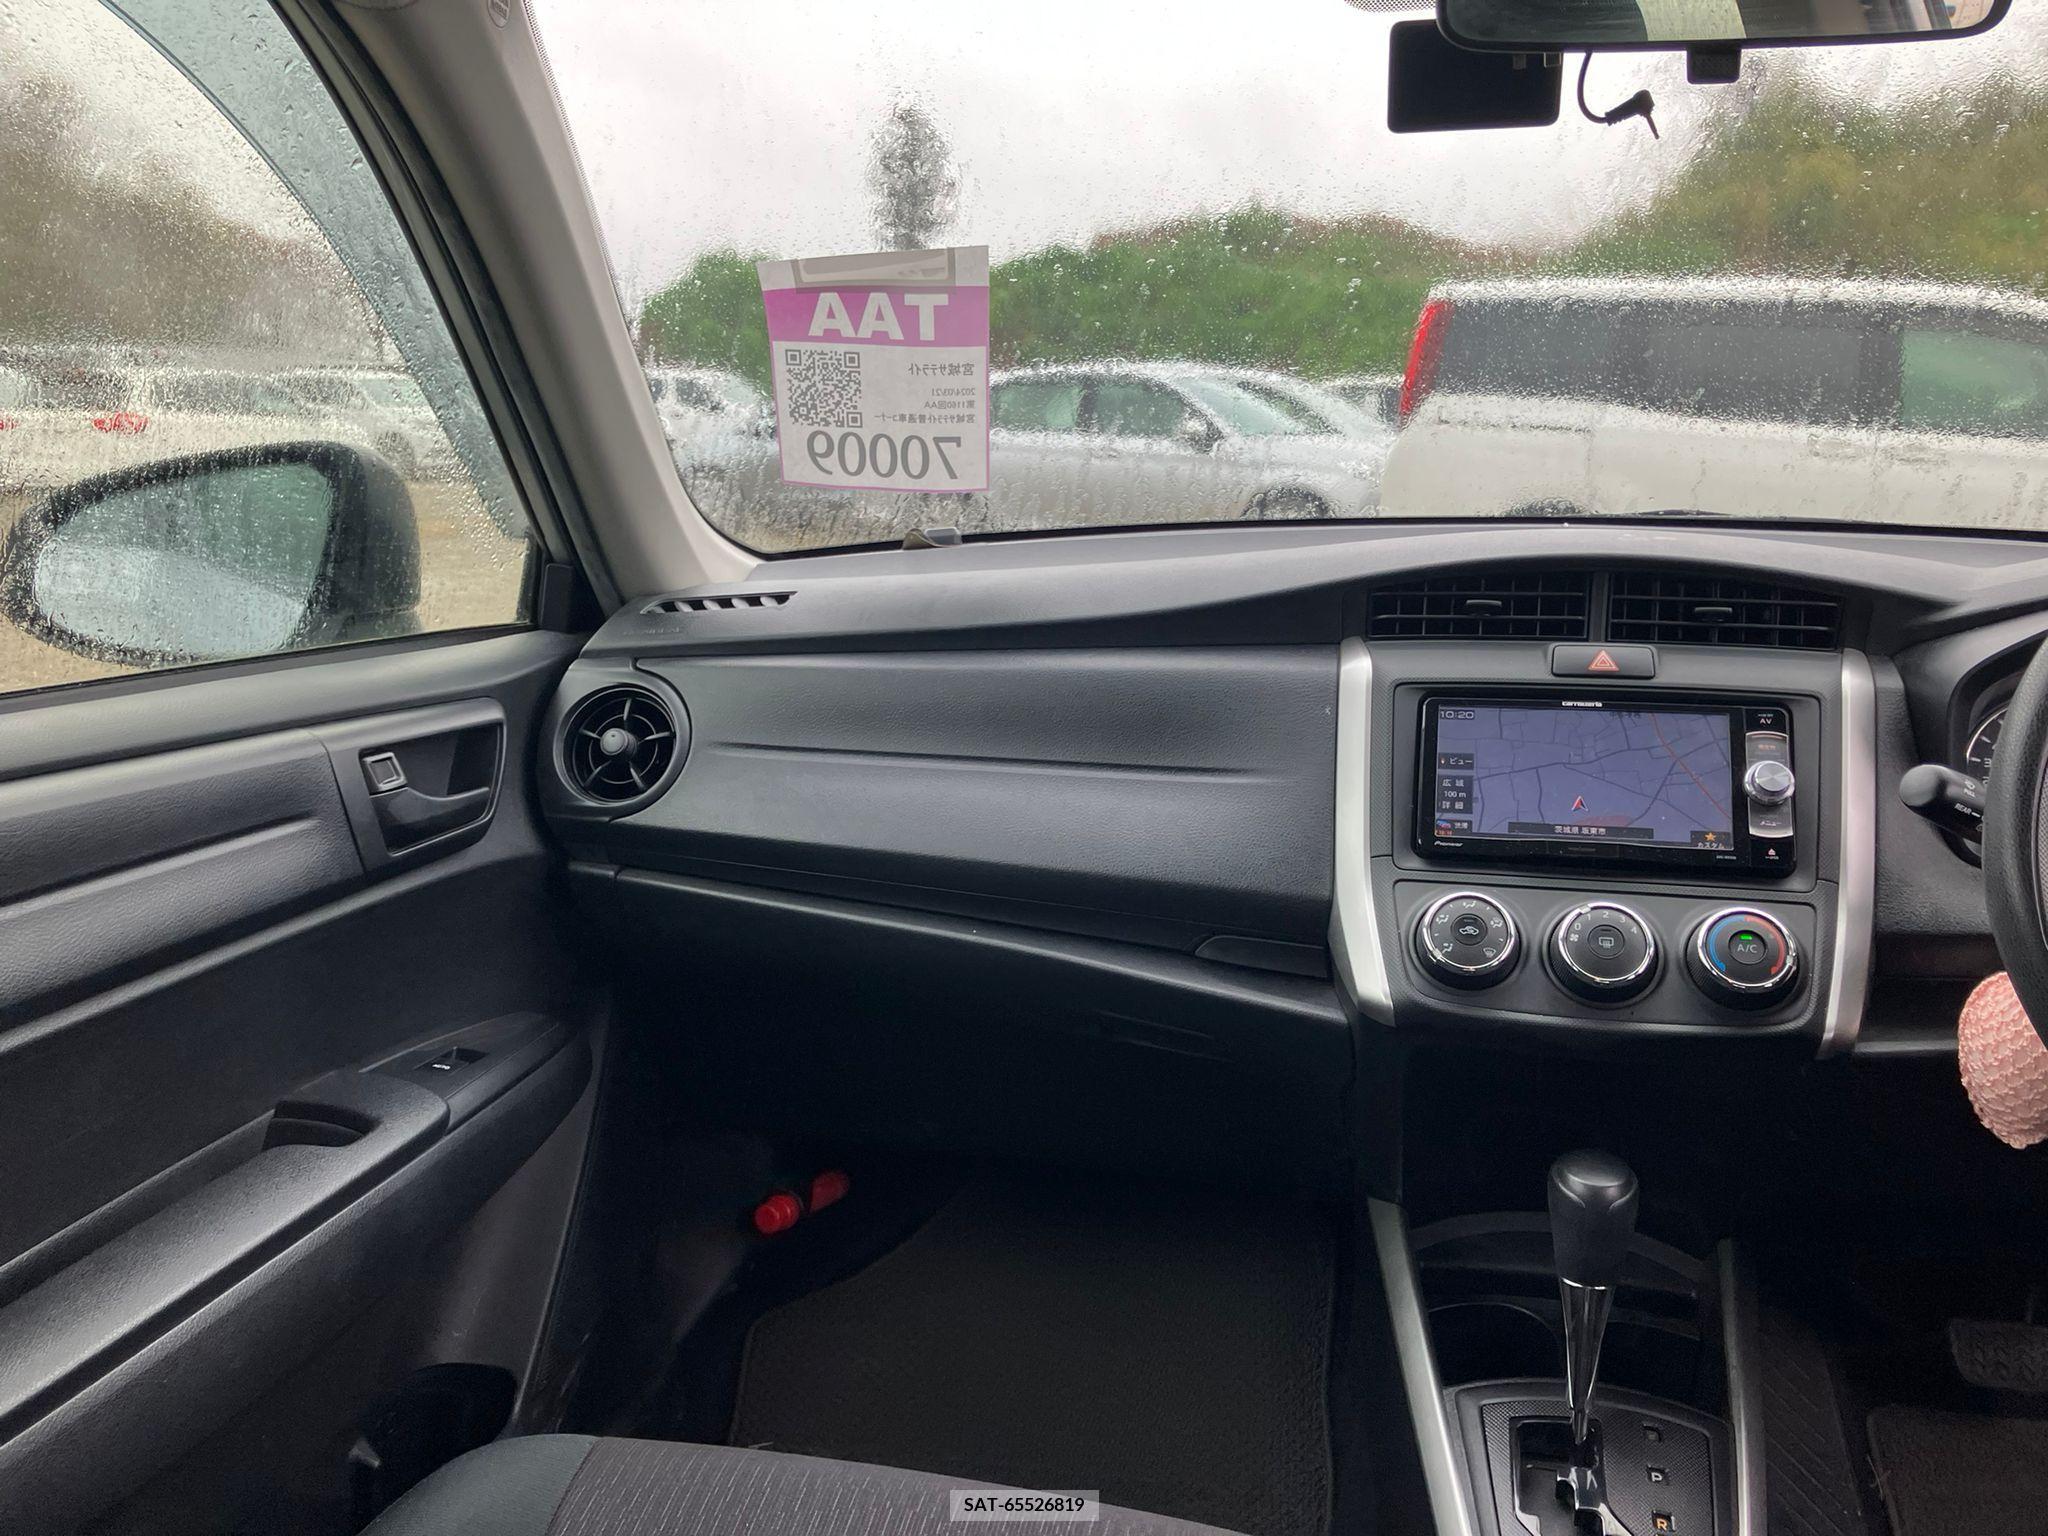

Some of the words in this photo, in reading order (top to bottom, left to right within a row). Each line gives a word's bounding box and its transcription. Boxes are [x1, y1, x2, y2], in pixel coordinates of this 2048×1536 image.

[1440, 710, 1474, 719] 10:20
[1954, 803, 1972, 815] REAR
[1602, 911, 1609, 919] 2
[1737, 944, 1758, 953] A/C
[1651, 1472, 1662, 1482] P
[1657, 1518, 1668, 1531] R
